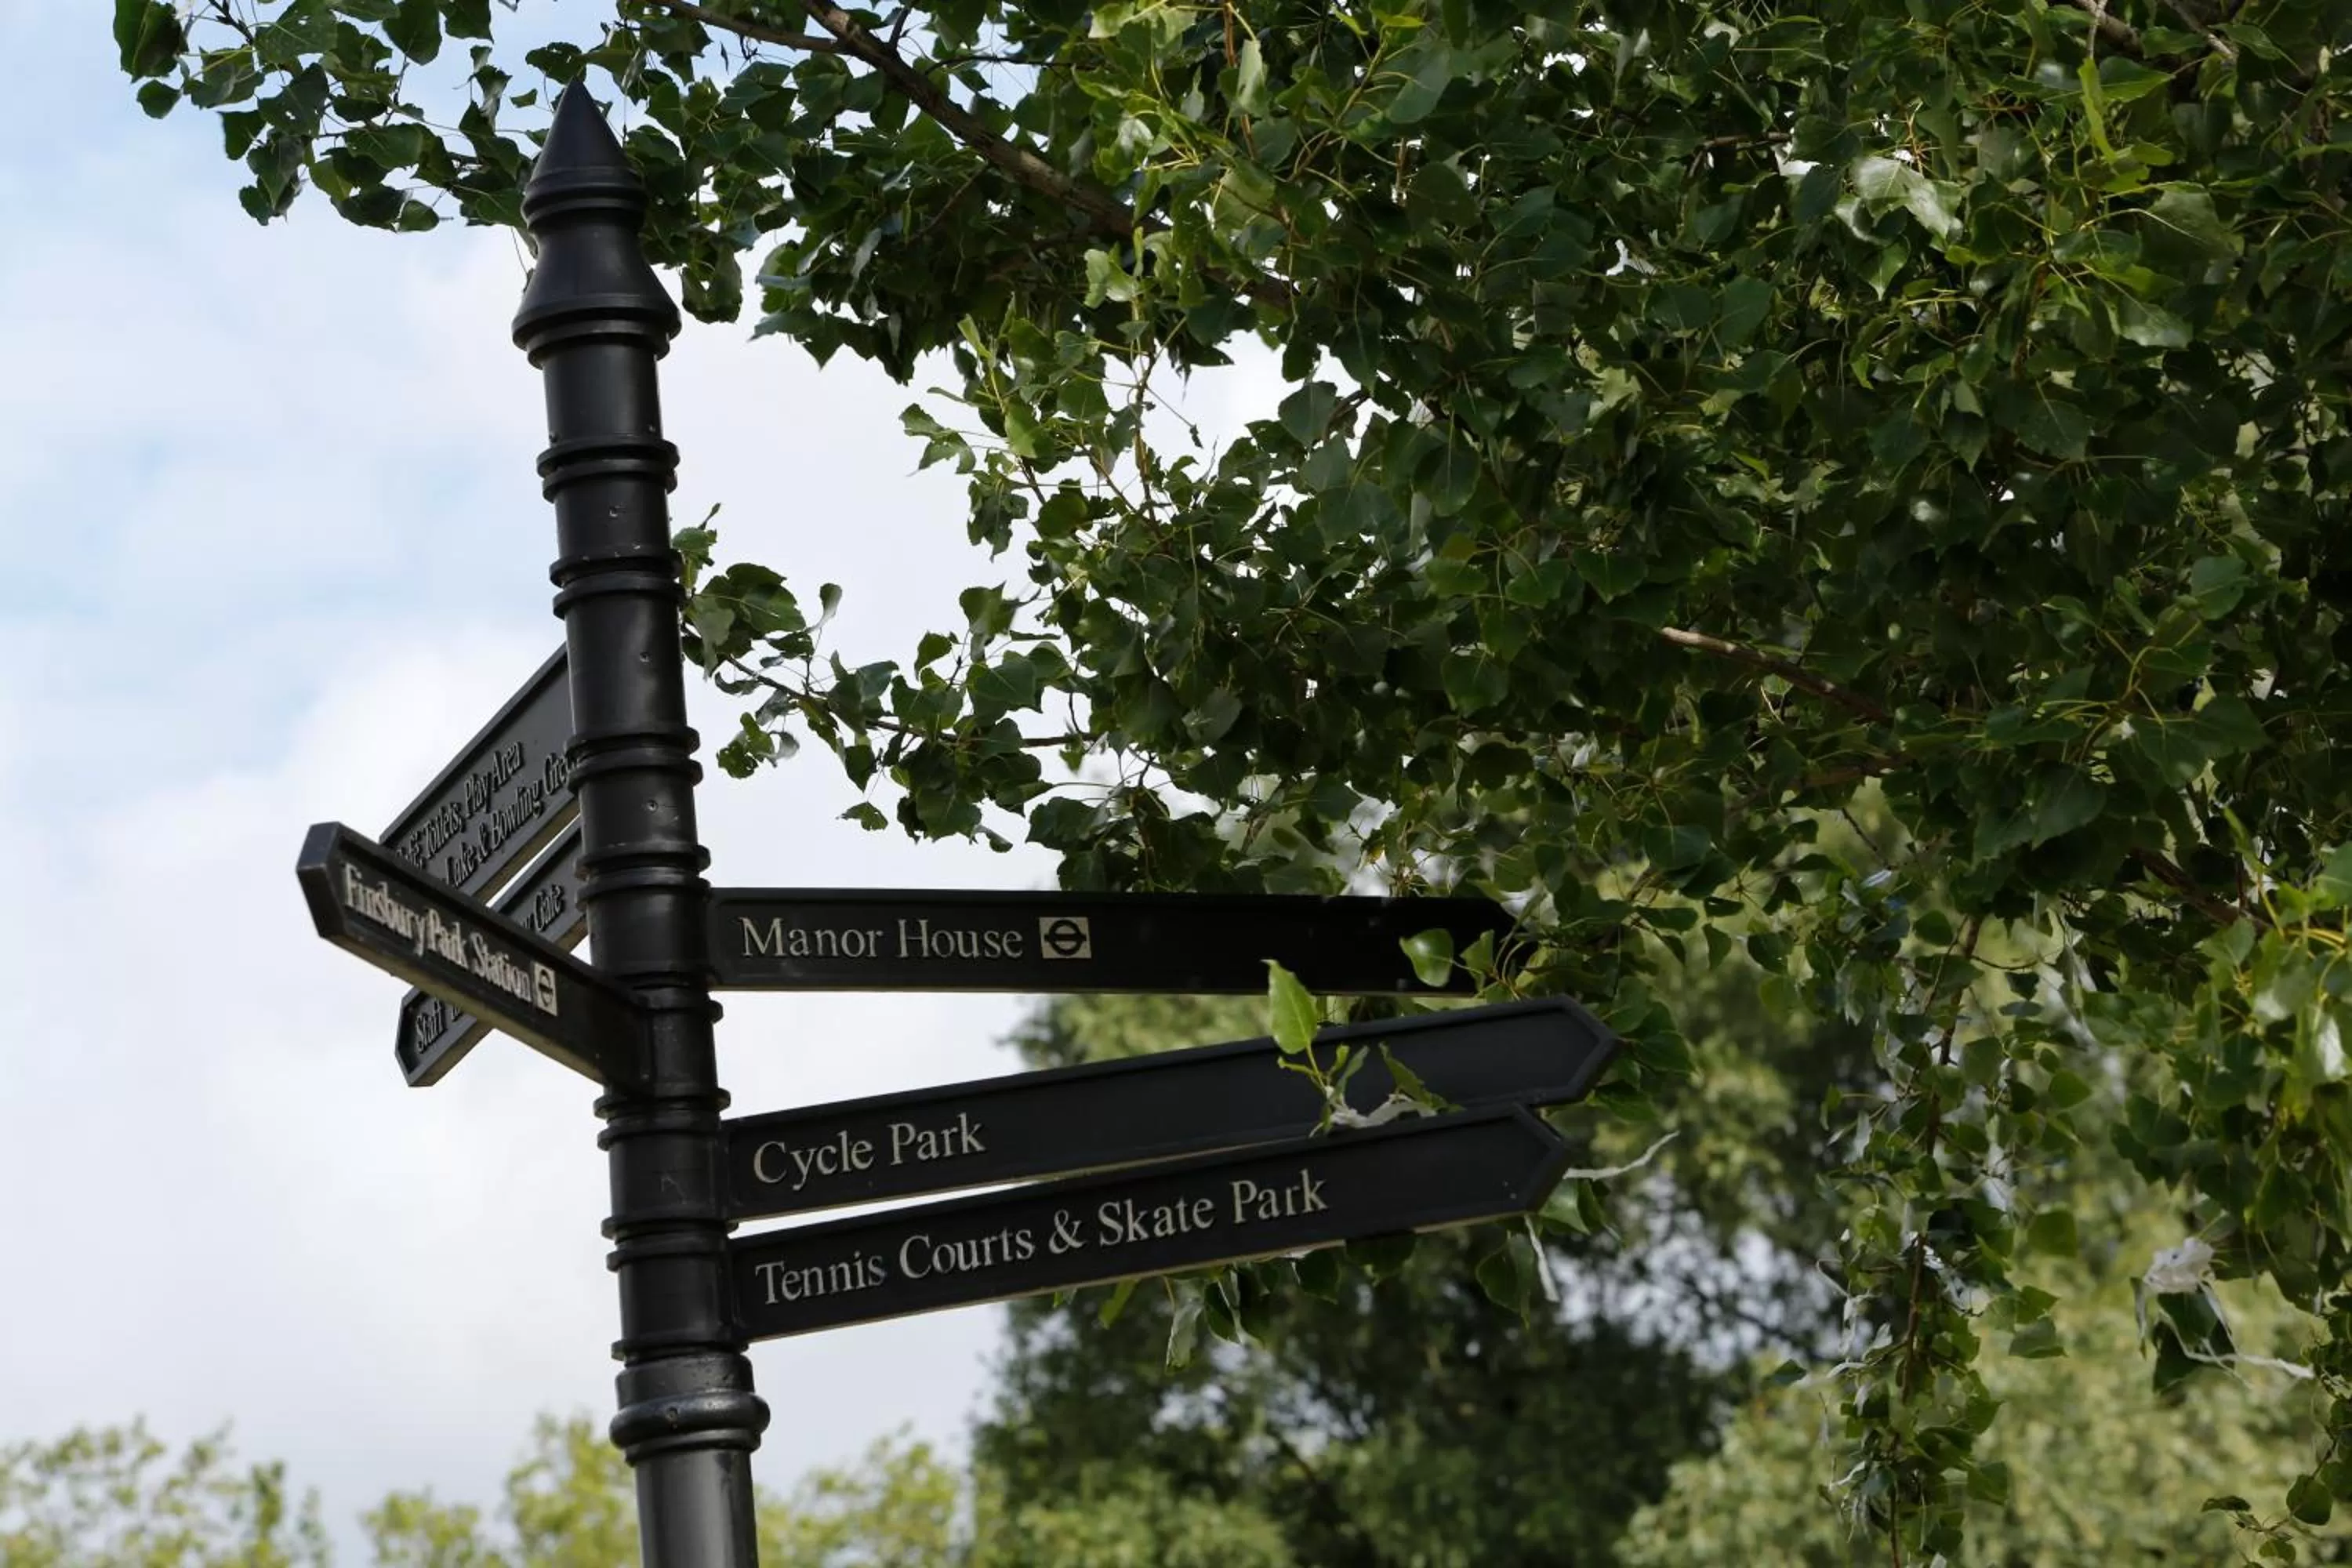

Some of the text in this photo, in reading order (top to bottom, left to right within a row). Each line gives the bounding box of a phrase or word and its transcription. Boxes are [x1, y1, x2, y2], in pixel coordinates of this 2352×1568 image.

[424, 802, 463, 859] Toilets,
[464, 774, 491, 818] Play
[492, 741, 523, 793] Area
[445, 841, 475, 887] Lake
[477, 822, 489, 862] &
[491, 779, 543, 851] Bowling
[343, 862, 532, 1002] Finsbury Park Station
[739, 917, 1023, 959] Manor House
[416, 998, 444, 1052] Staff
[753, 1112, 986, 1191] Cycle Park
[756, 1168, 1329, 1305] Tennis Courts & Skate Park
